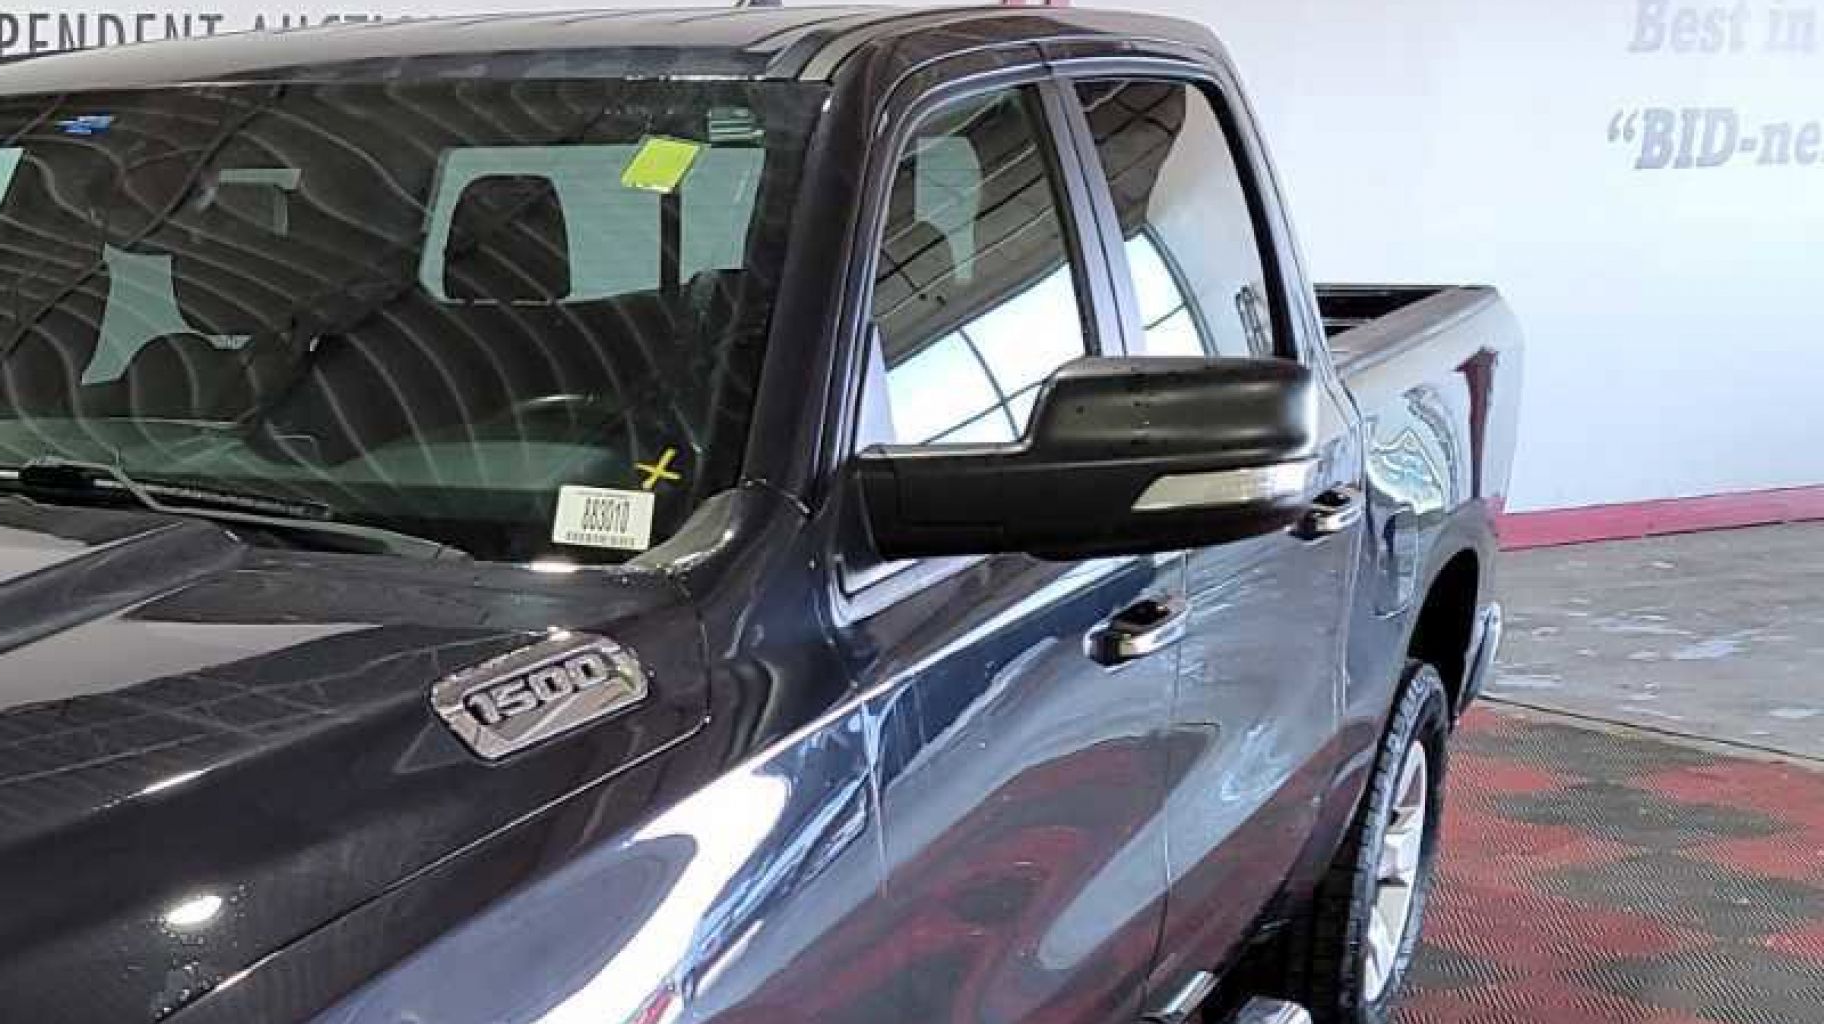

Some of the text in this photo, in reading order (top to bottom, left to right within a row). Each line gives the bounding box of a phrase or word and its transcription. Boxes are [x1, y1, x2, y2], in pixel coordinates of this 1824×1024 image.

[1627, 0, 1751, 53] Best
[1606, 107, 1824, 170] “BID-ne
[463, 652, 610, 727] 1500
